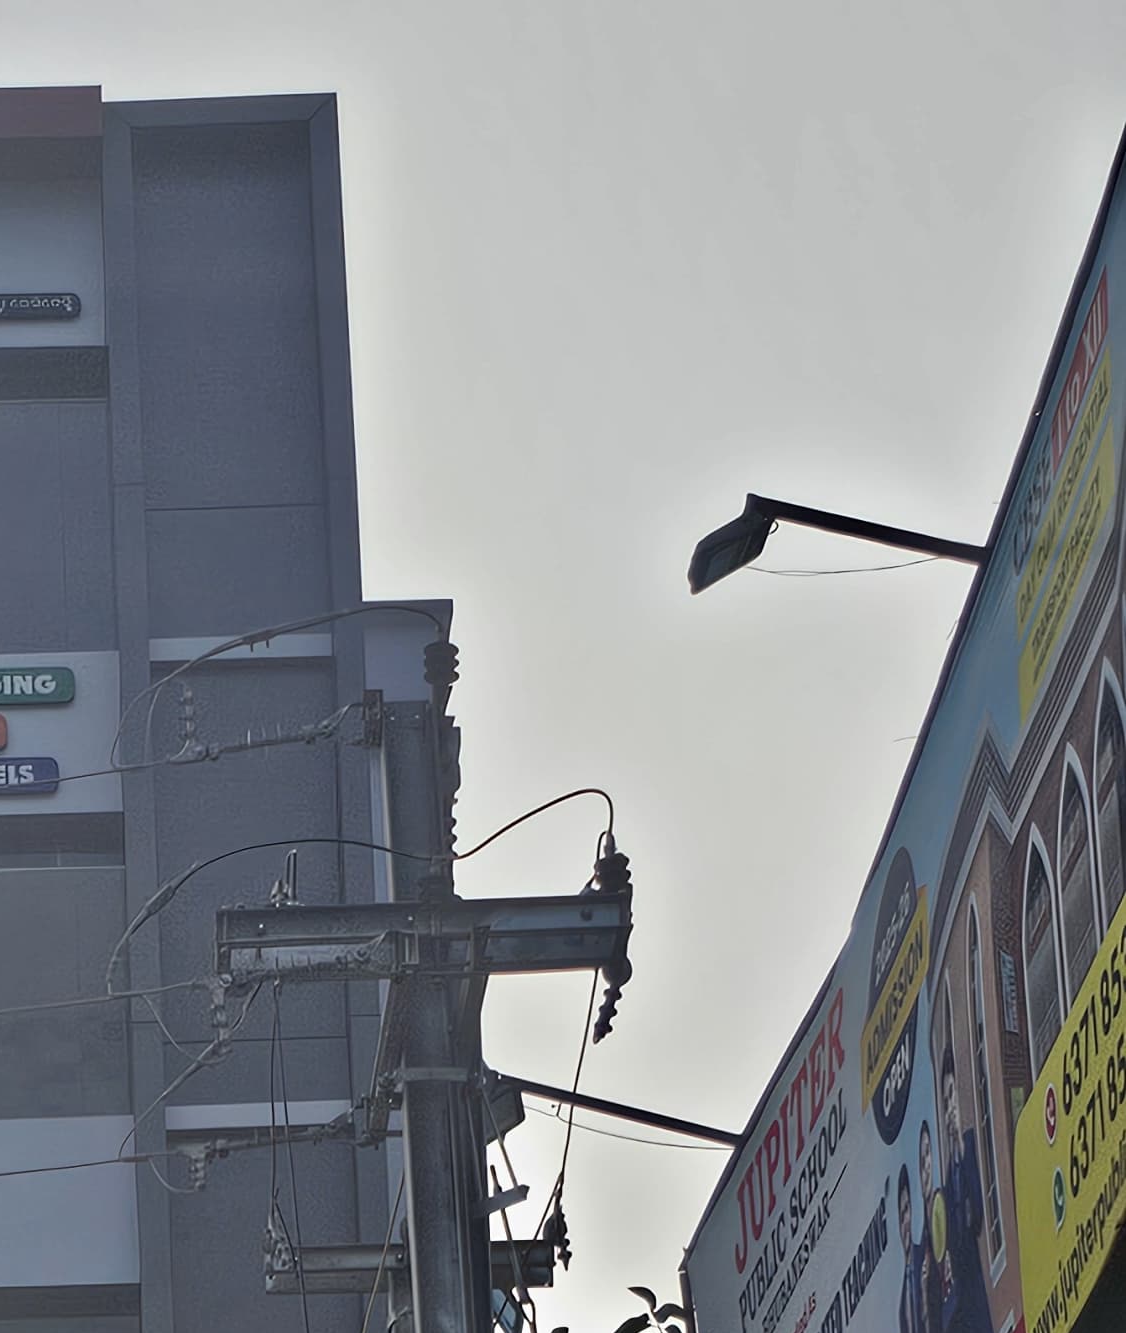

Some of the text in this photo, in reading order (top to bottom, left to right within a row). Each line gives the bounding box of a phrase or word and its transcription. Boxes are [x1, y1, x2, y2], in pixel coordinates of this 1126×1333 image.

[866, 921, 924, 1086] ADMISSION
[1063, 994, 1099, 1116] 6371
[735, 986, 845, 1275] JUPITER
[882, 1033, 910, 1117] OPEN
[1069, 1079, 1106, 1199] 6371
[789, 1086, 847, 1239] SCHOOL
